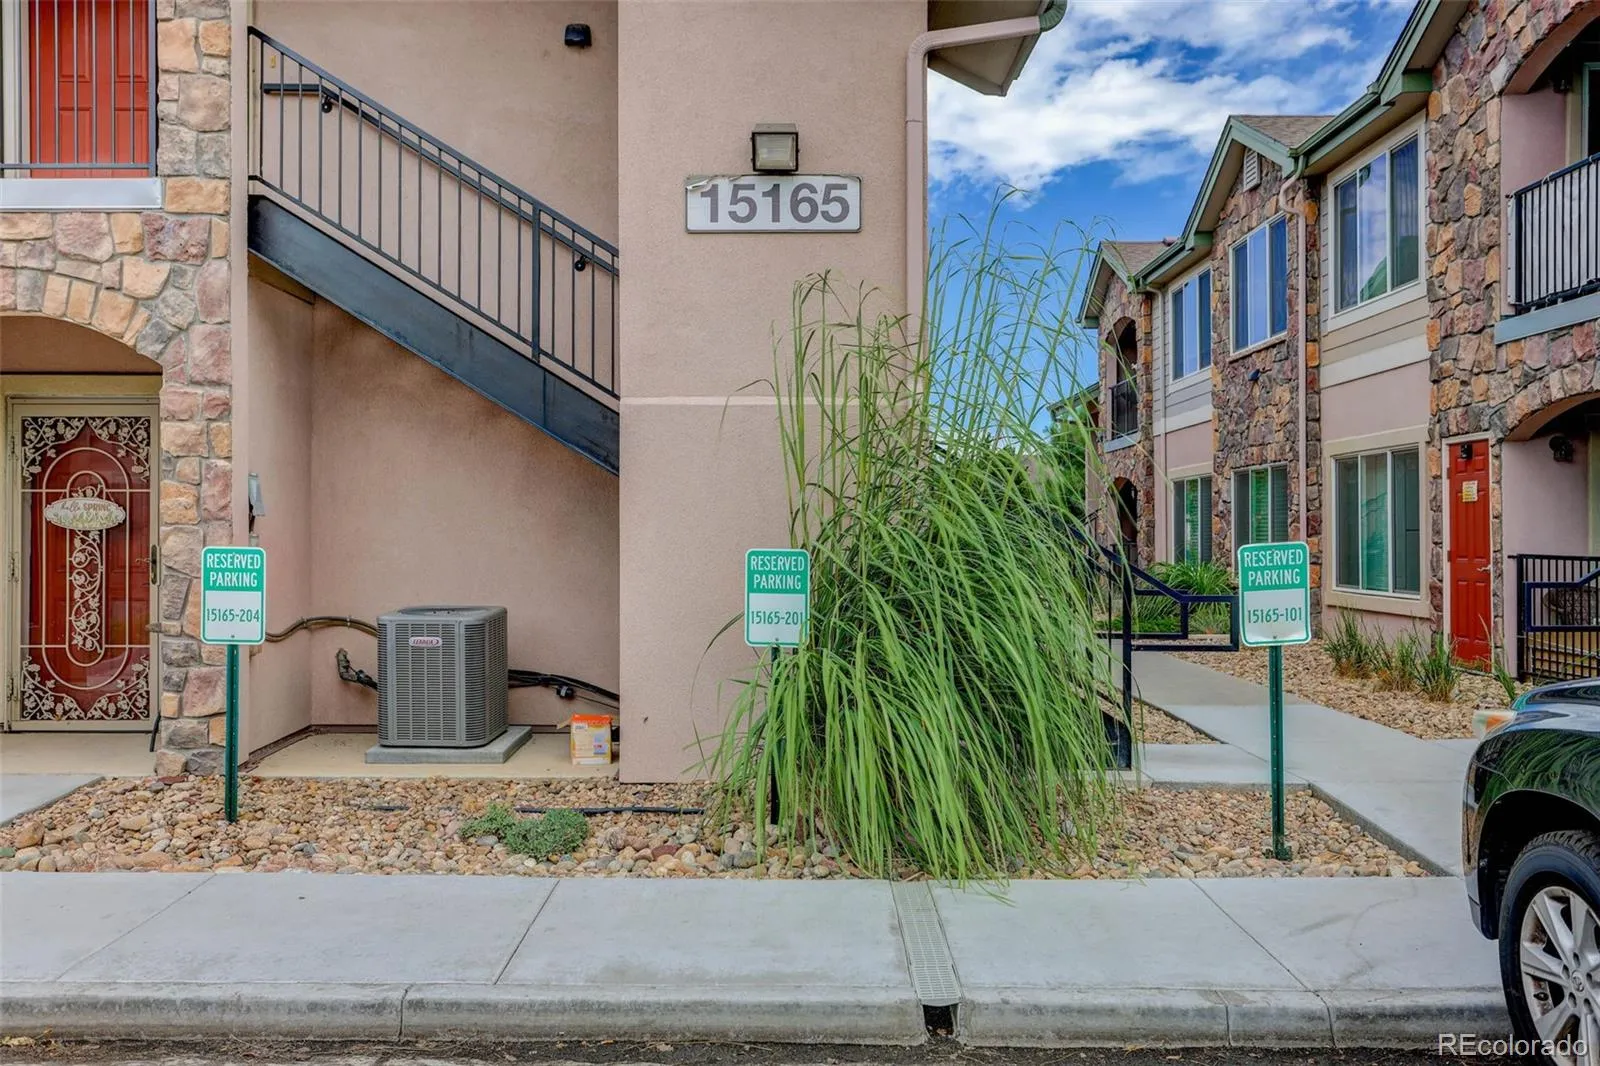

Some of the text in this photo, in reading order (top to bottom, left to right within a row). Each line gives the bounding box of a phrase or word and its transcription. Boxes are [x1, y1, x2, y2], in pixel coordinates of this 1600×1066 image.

[700, 183, 850, 224] 15165
[206, 553, 261, 569] RESERVED
[750, 555, 805, 571] RESERVED
[1244, 549, 1304, 567] RESERVED
[209, 571, 258, 587] PARKING
[753, 574, 802, 589] PARKING
[1248, 569, 1301, 586] PARKING
[207, 608, 260, 622] 15165-204
[751, 610, 804, 625] 15165-201
[1248, 607, 1302, 623] 15165-101
